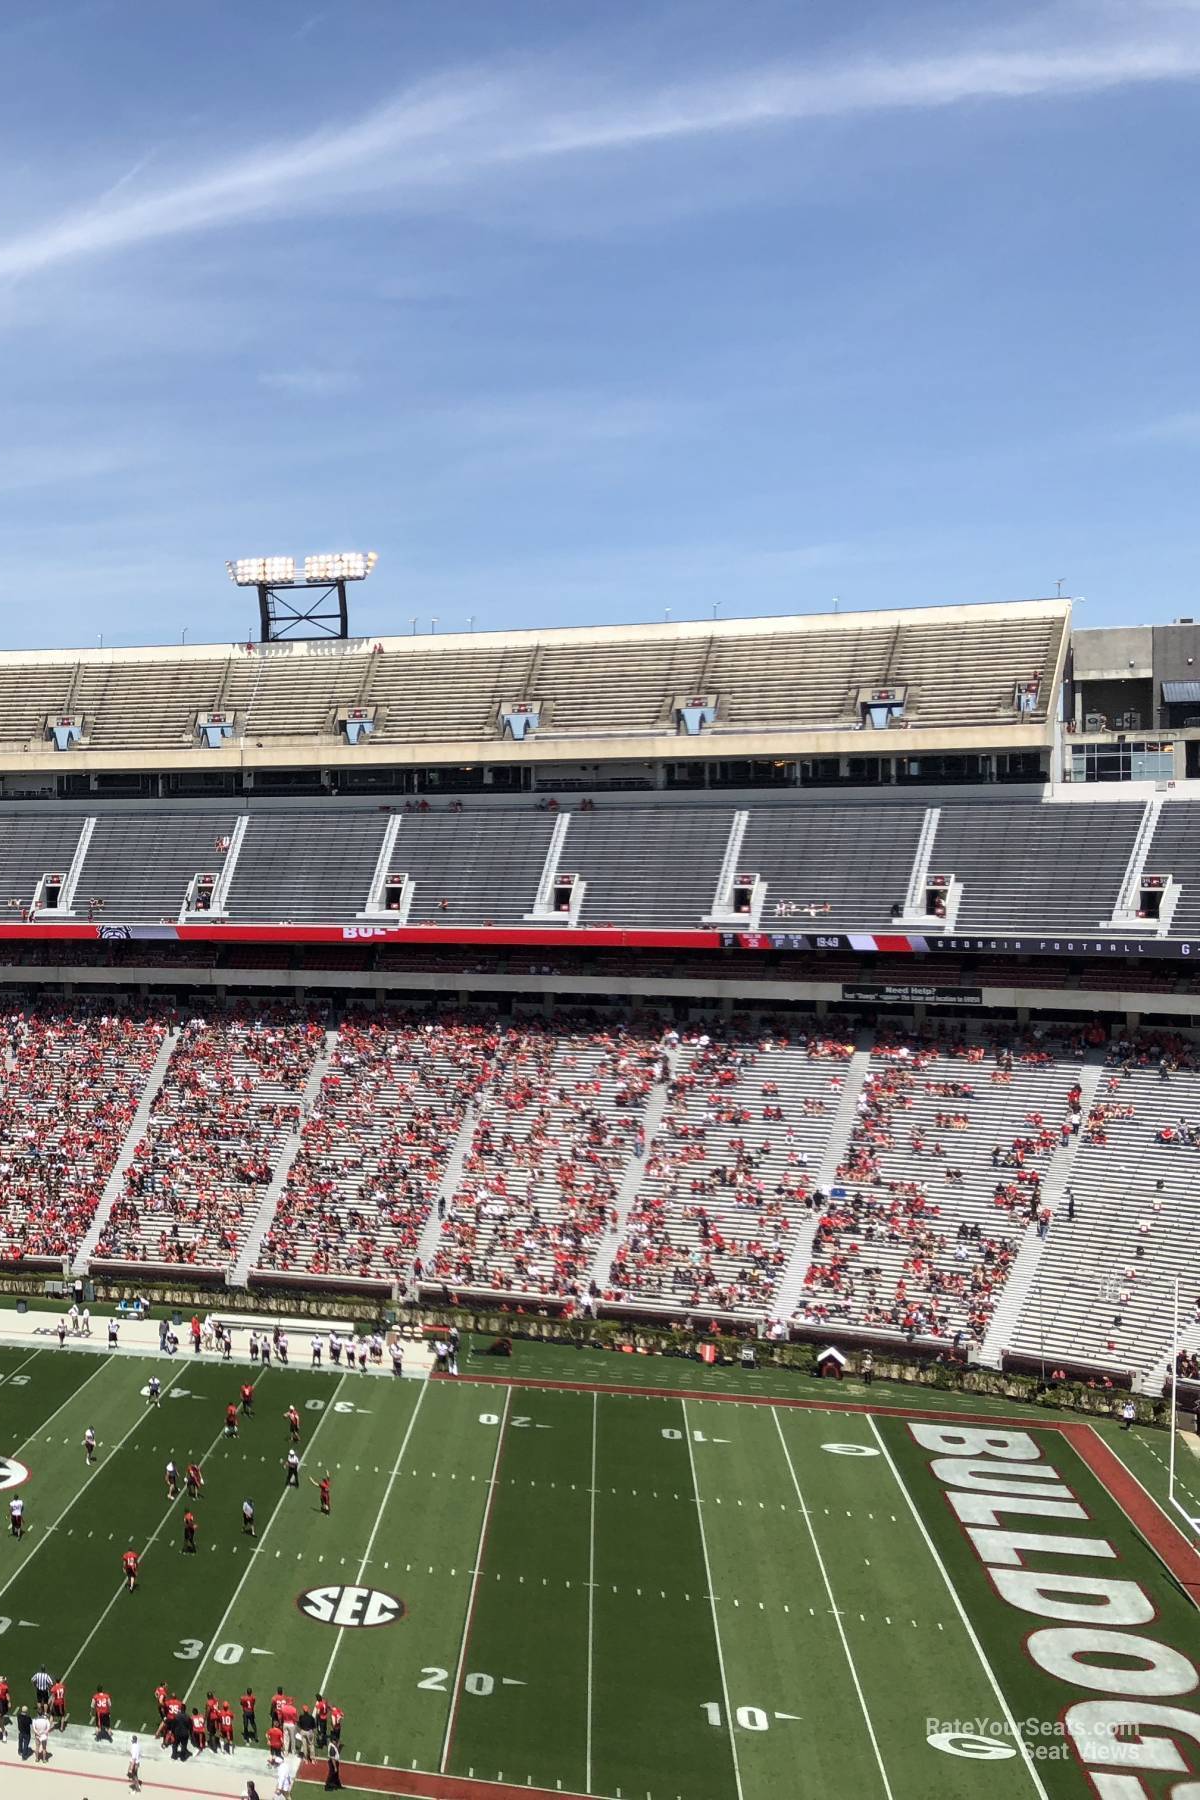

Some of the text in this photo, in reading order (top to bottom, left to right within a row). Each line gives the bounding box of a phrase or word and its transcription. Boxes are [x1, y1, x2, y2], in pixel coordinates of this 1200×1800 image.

[817, 937, 839, 948] 19:49
[885, 986, 937, 995] Need Help?
[305, 1399, 355, 1413] 30
[478, 1413, 531, 1427] 20
[661, 1428, 708, 1442] 10
[300, 1585, 402, 1626] SEC
[173, 1639, 245, 1665] 30
[417, 1667, 495, 1696] 20
[221, 1714, 232, 1726] 10
[700, 1702, 770, 1732] 10
